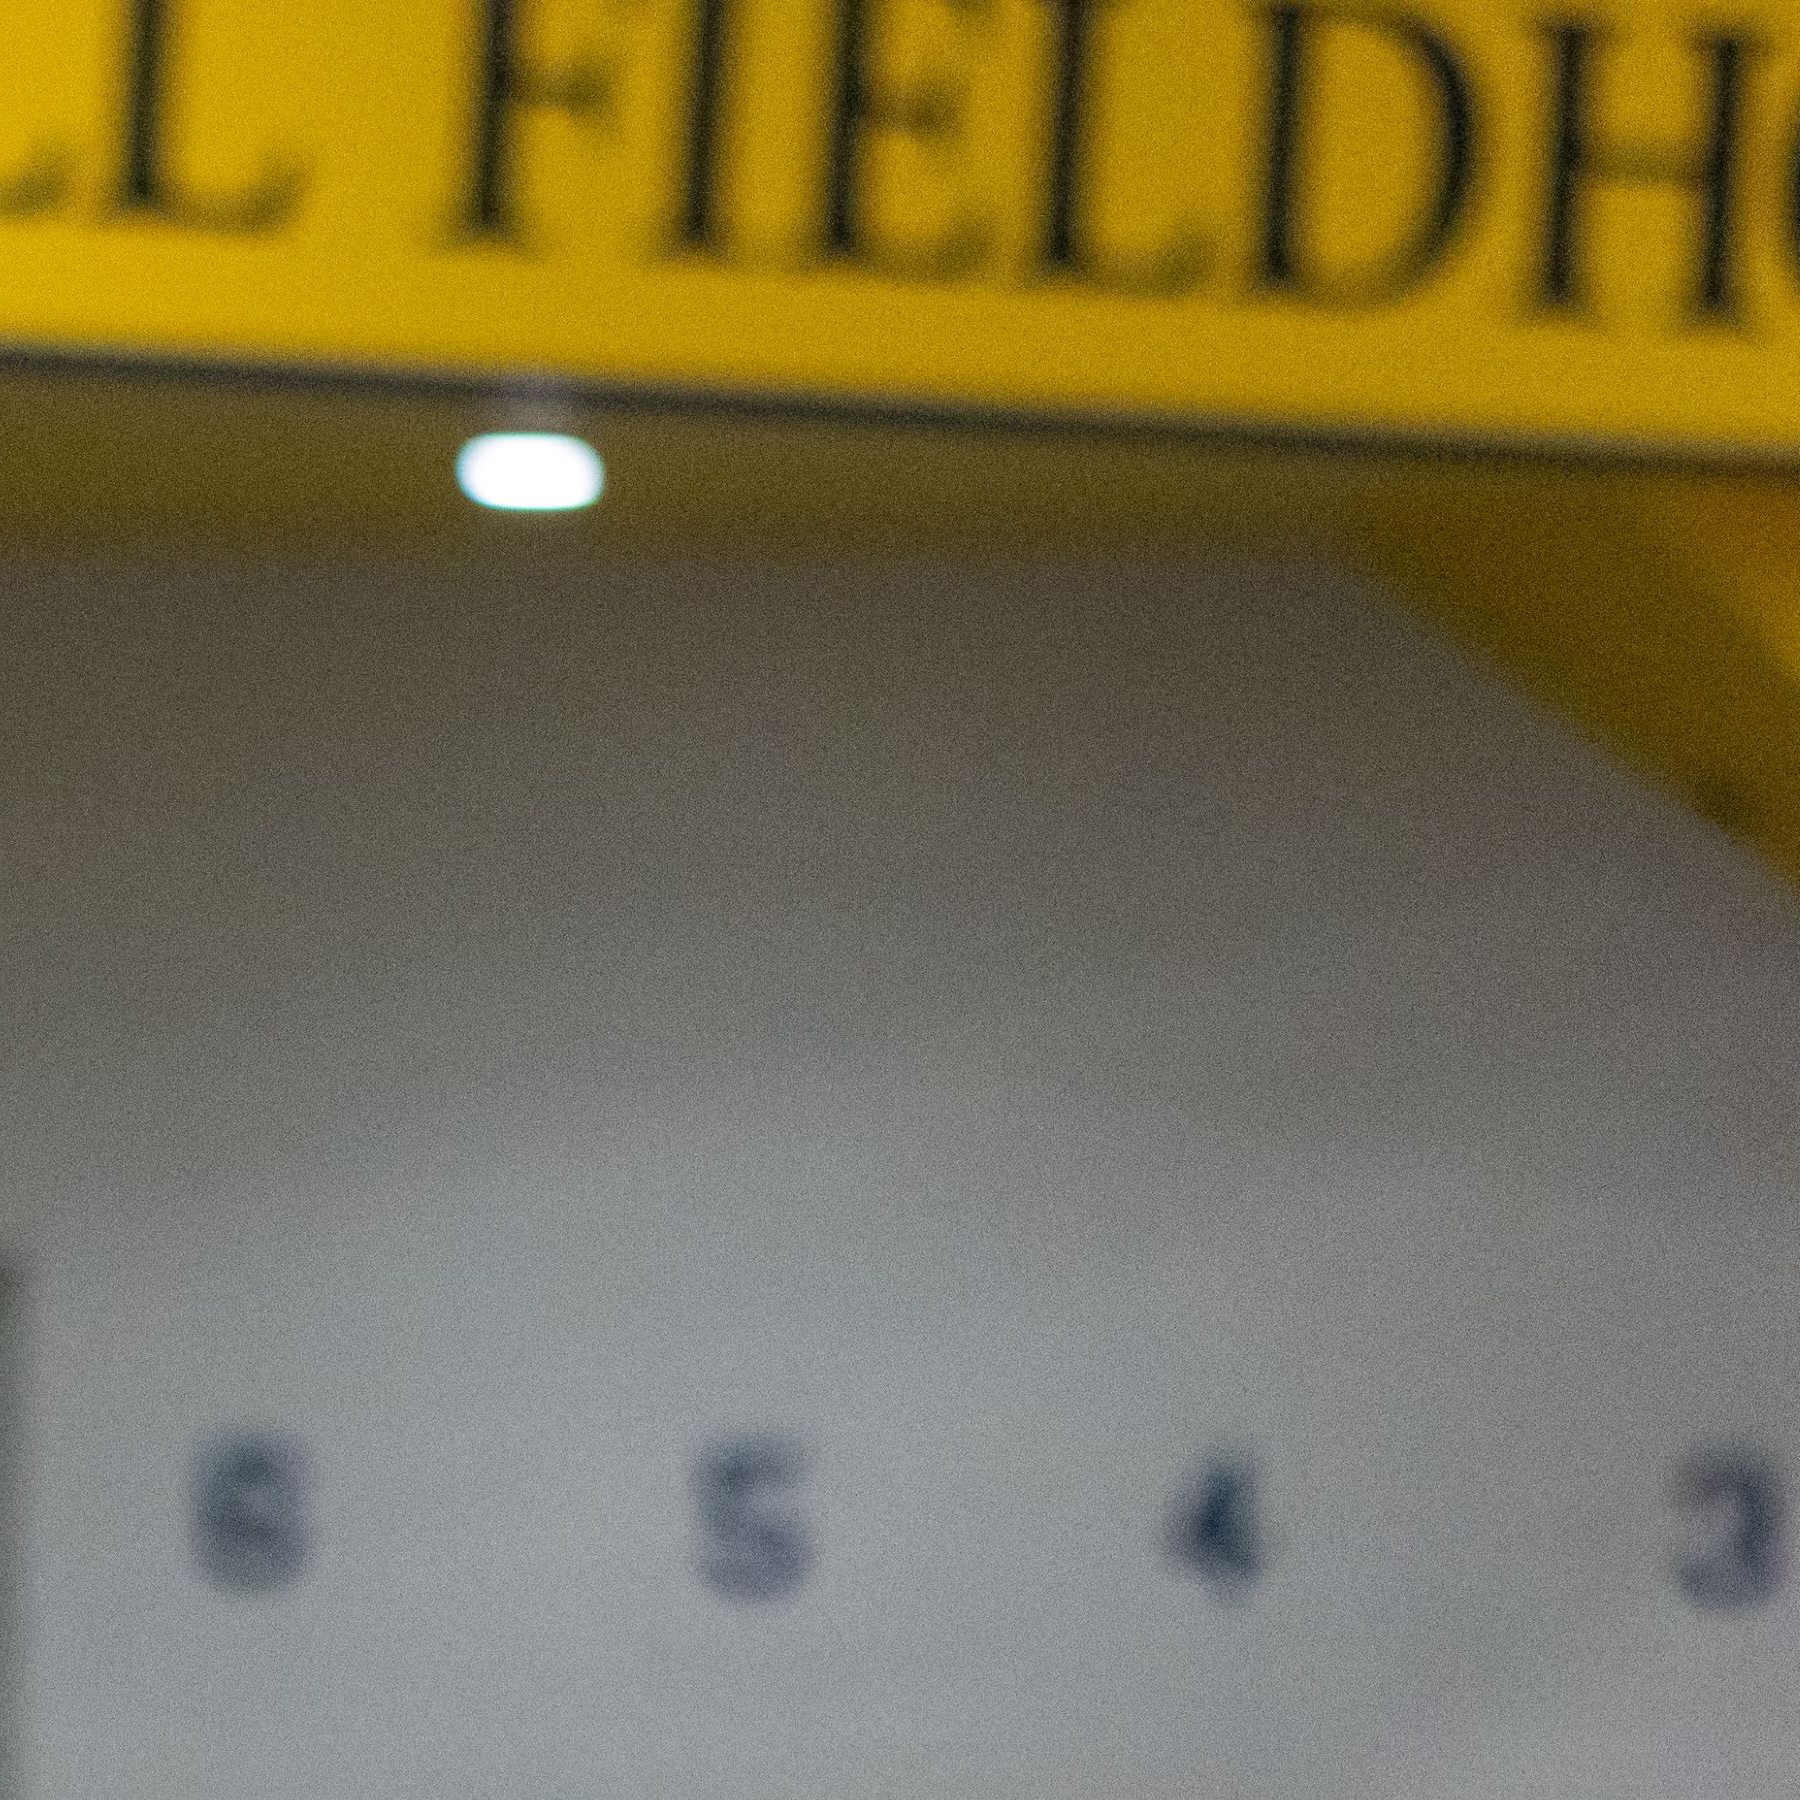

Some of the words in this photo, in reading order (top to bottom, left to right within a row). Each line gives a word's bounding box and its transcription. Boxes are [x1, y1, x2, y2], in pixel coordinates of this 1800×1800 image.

[434, 0, 1800, 338] FIELDH
[693, 1430, 815, 1608] 5
[1161, 1440, 1269, 1608] 4
[1667, 1440, 1787, 1615] 3
